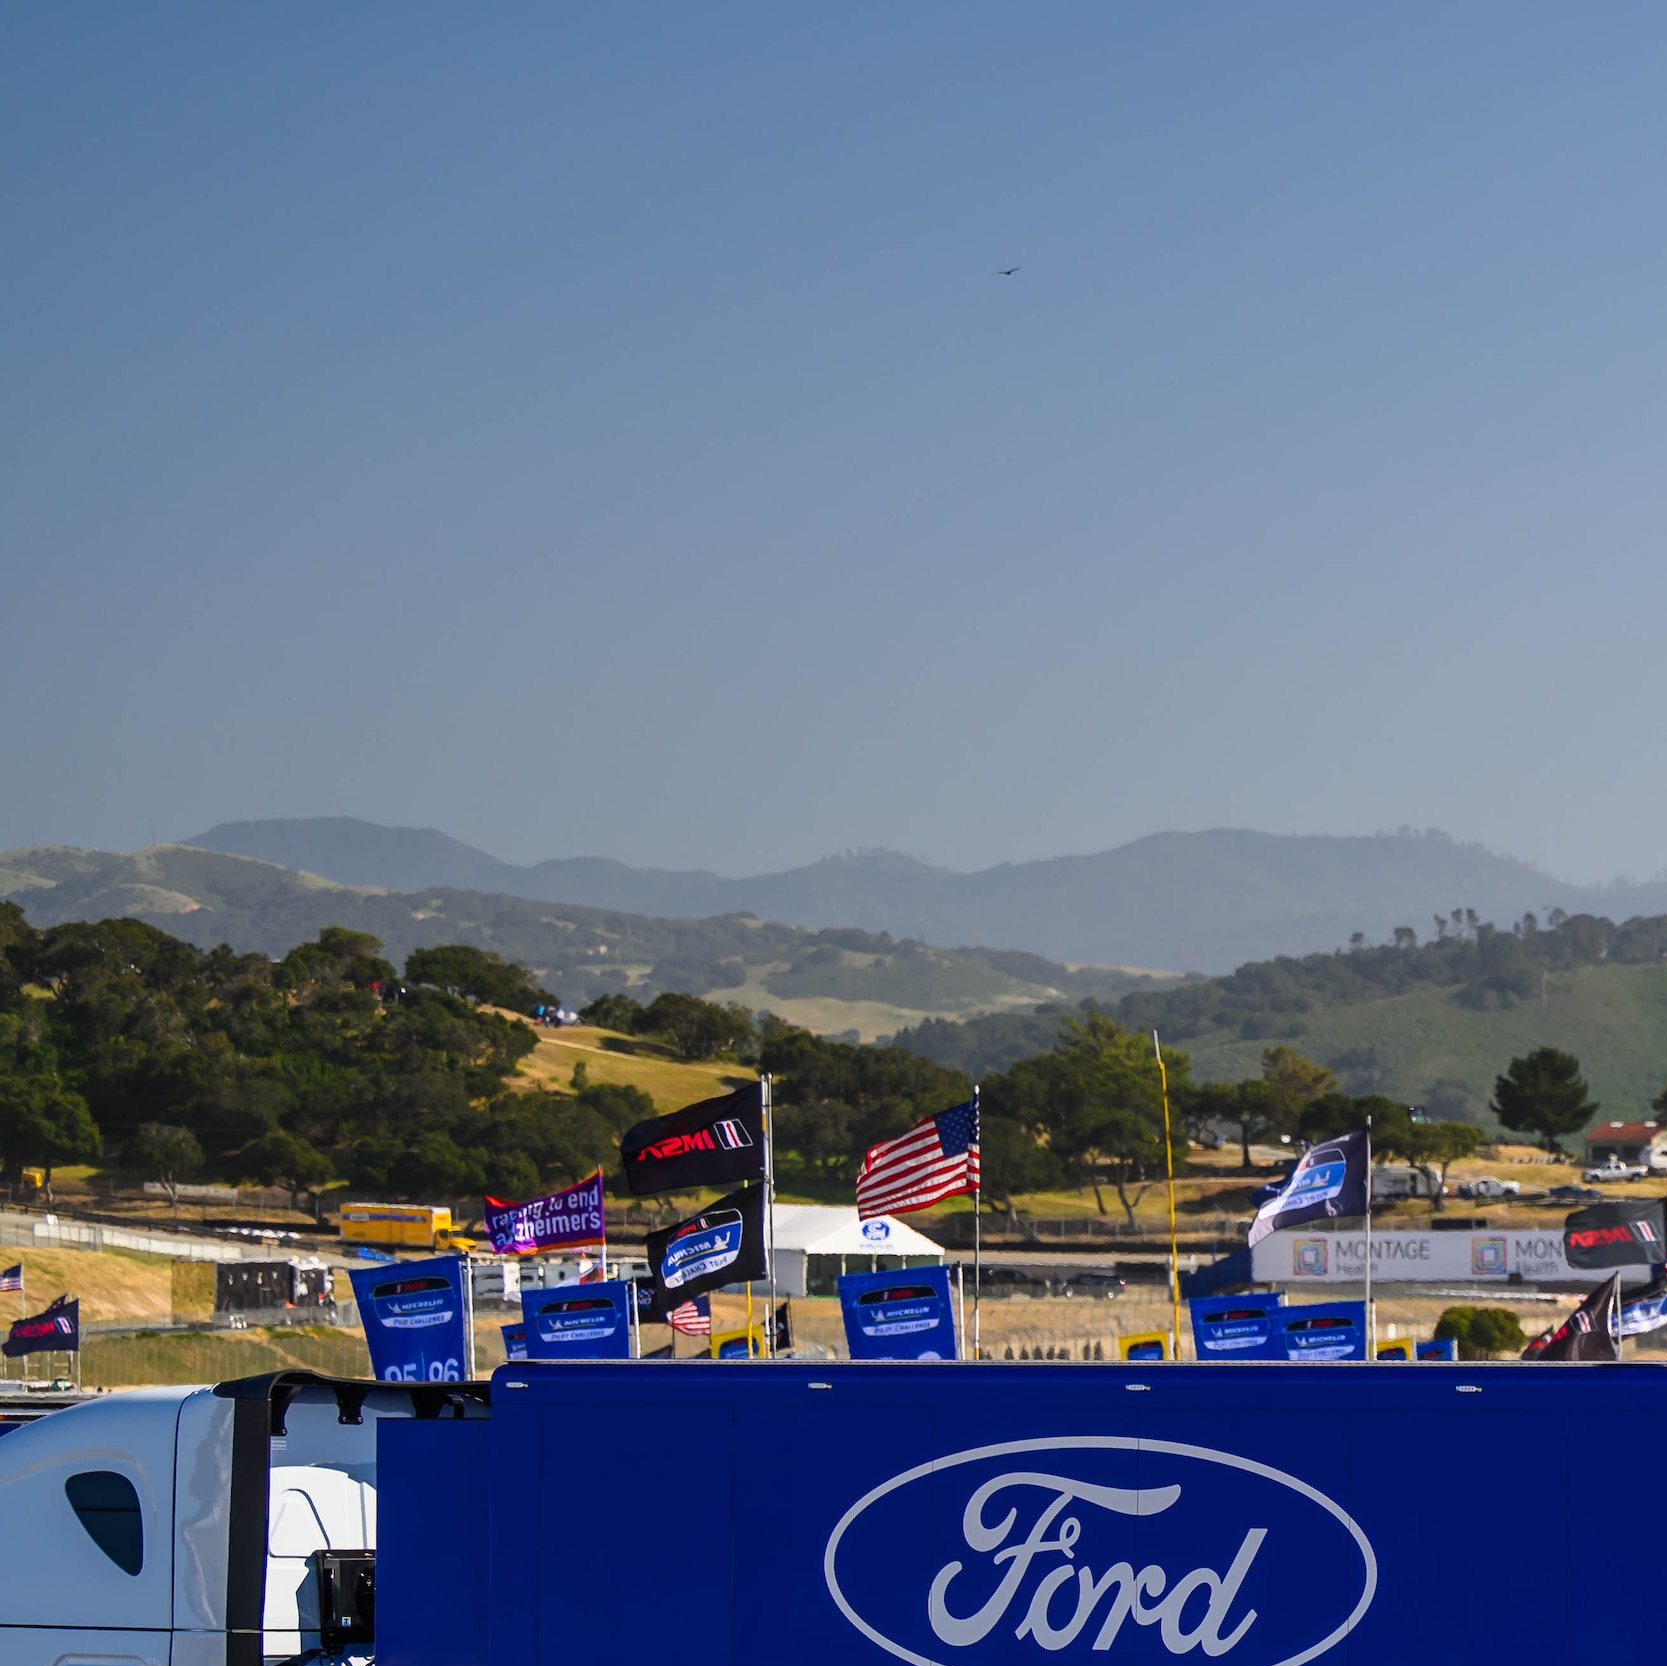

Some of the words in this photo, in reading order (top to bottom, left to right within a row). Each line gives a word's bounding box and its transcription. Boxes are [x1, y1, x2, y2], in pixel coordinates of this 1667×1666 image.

[568, 1185, 599, 1208] end
[1336, 1238, 1431, 1260] MONTAGE
[928, 1471, 1268, 1657] Ford
